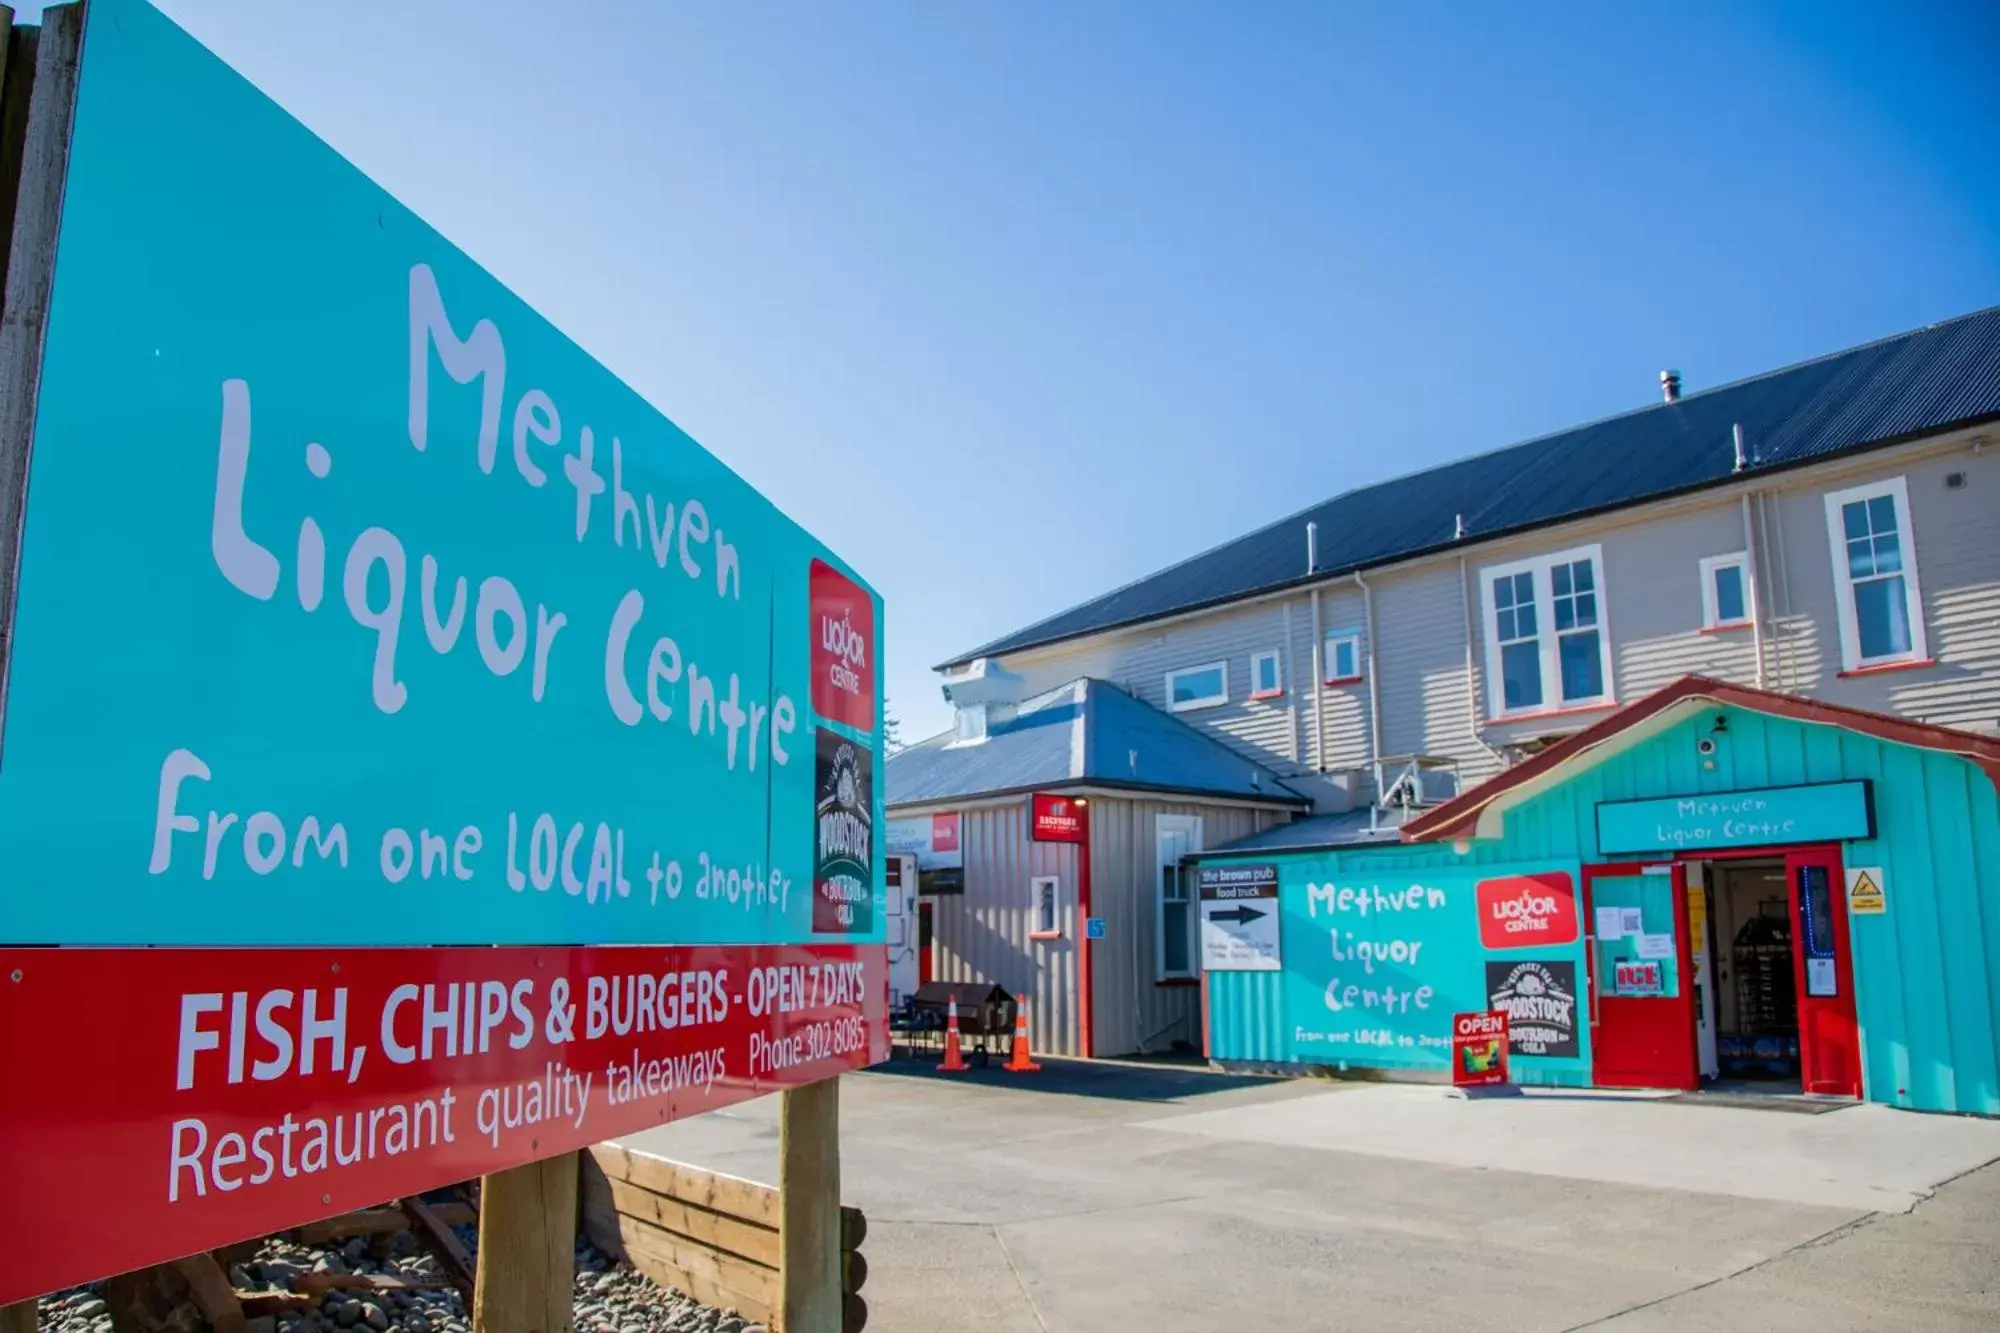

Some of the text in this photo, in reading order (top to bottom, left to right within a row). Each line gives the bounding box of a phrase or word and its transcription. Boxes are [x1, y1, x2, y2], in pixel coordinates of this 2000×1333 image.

[408, 263, 739, 600] Methven
[212, 378, 796, 772] Liquor Centre
[822, 615, 866, 668] LIQUOR
[830, 664, 860, 695] CENTRE
[1677, 799, 1767, 818] Methven
[149, 748, 791, 913] From one LOCAL to another
[1657, 818, 1795, 846] Liquor Centre
[1203, 866, 1274, 882] the brown pub
[1216, 886, 1260, 898] food truck
[1306, 882, 1446, 918] Methven
[1492, 896, 1558, 919] LIQUOR
[1504, 917, 1548, 932] CENTRE
[1330, 927, 1422, 974] Liquor
[1324, 977, 1434, 1015] Centre
[176, 961, 865, 1091] FISH, CHIPS & BURGERS - OPEN 7 DAYS
[1295, 1025, 1323, 1042] From
[1328, 1032, 1350, 1043] one
[1354, 1028, 1393, 1047] LOCAL
[1397, 1034, 1414, 1047] to
[1459, 1016, 1503, 1034] OPEN
[1522, 1042, 1546, 1054] COLA
[169, 1016, 865, 1203] Restaurant quality takeaways Phone 302 8085
